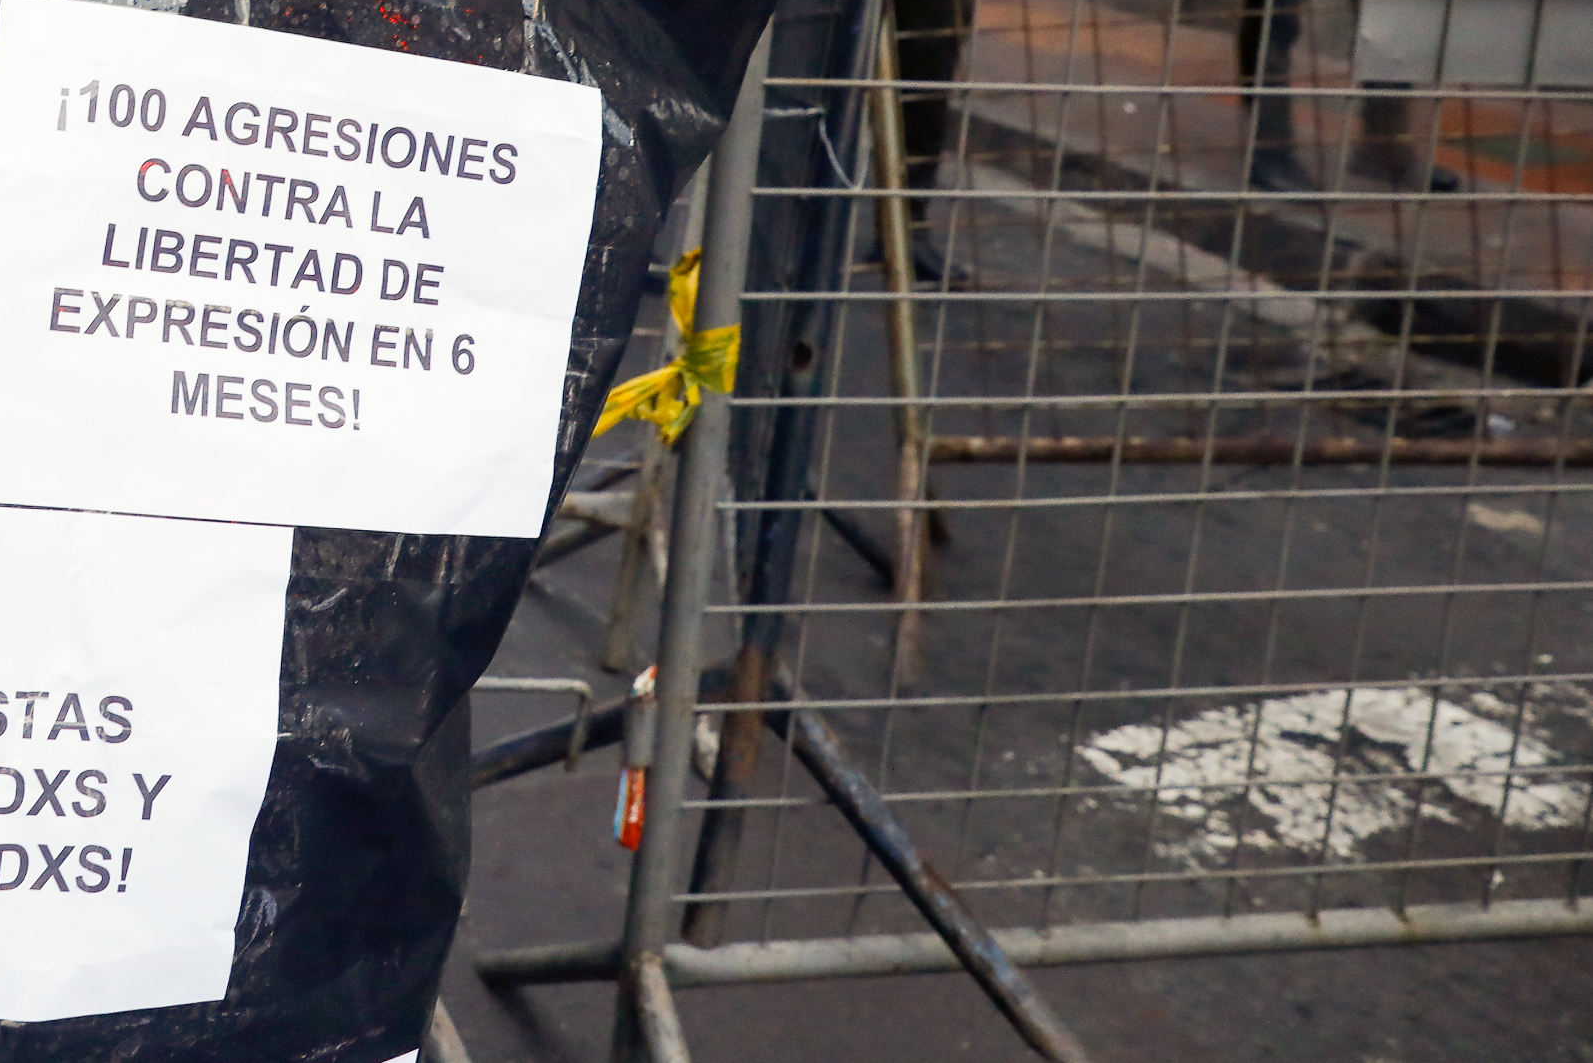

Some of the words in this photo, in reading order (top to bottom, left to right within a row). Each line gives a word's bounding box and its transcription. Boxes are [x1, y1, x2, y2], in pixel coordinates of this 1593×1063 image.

[58, 80, 166, 132] ¡100
[182, 96, 518, 184] AGRESIONES
[137, 158, 353, 228] CONTRA
[371, 191, 430, 239] LA
[102, 223, 363, 295] LIBERTAD
[380, 259, 444, 306] DE
[50, 287, 354, 362] EXPRESIÓN
[371, 324, 433, 371] EN
[452, 334, 475, 375] 6
[171, 371, 360, 430] MESES!
[132, 773, 172, 820] Y
